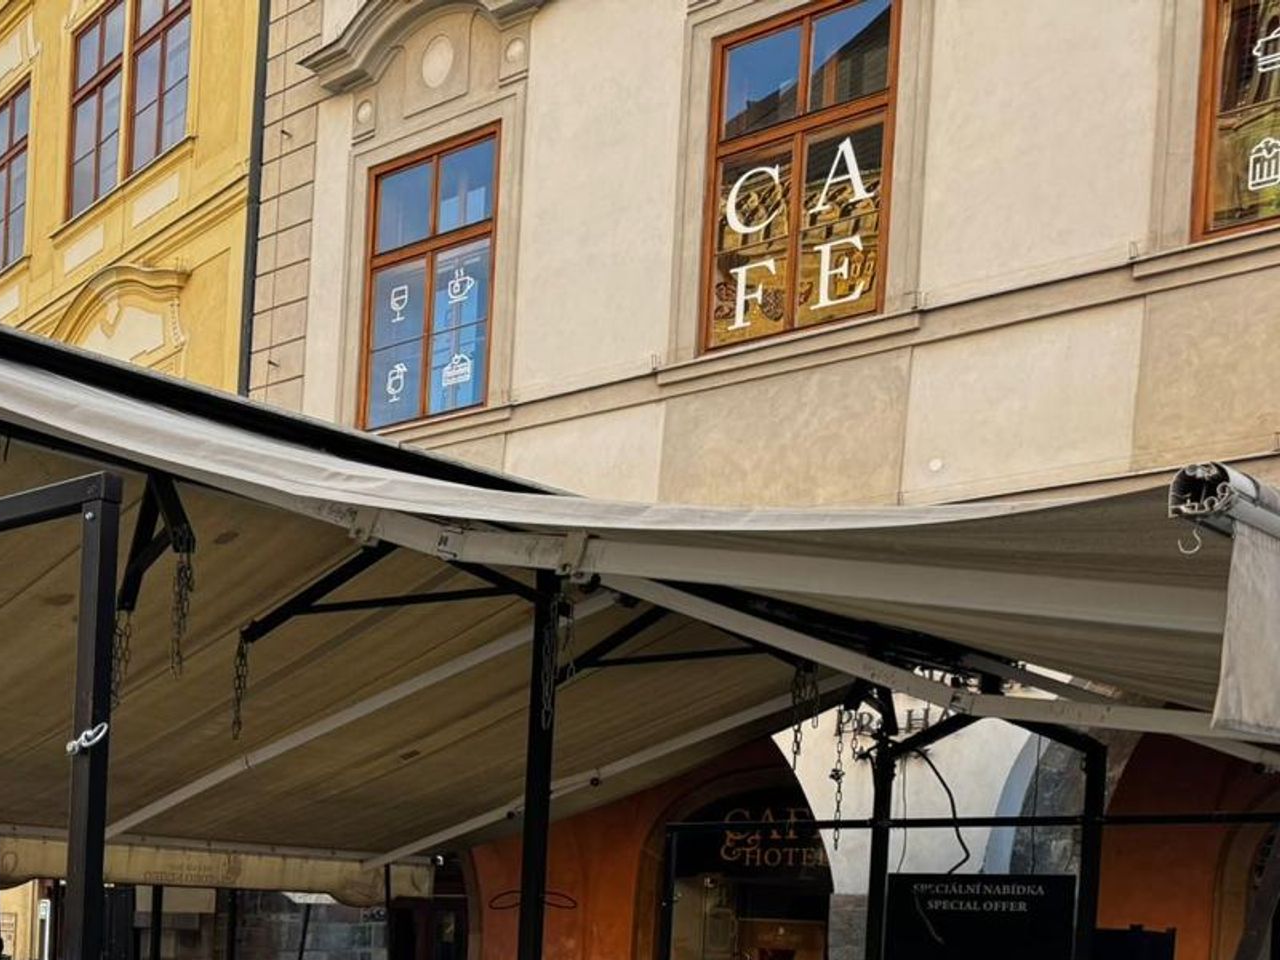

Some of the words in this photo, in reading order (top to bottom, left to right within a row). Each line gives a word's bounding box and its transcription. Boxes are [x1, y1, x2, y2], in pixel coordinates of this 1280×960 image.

[982, 882, 1046, 896] NABÍDKA
[927, 899, 981, 911] SPECIAL
[982, 900, 1028, 912] OFFER
